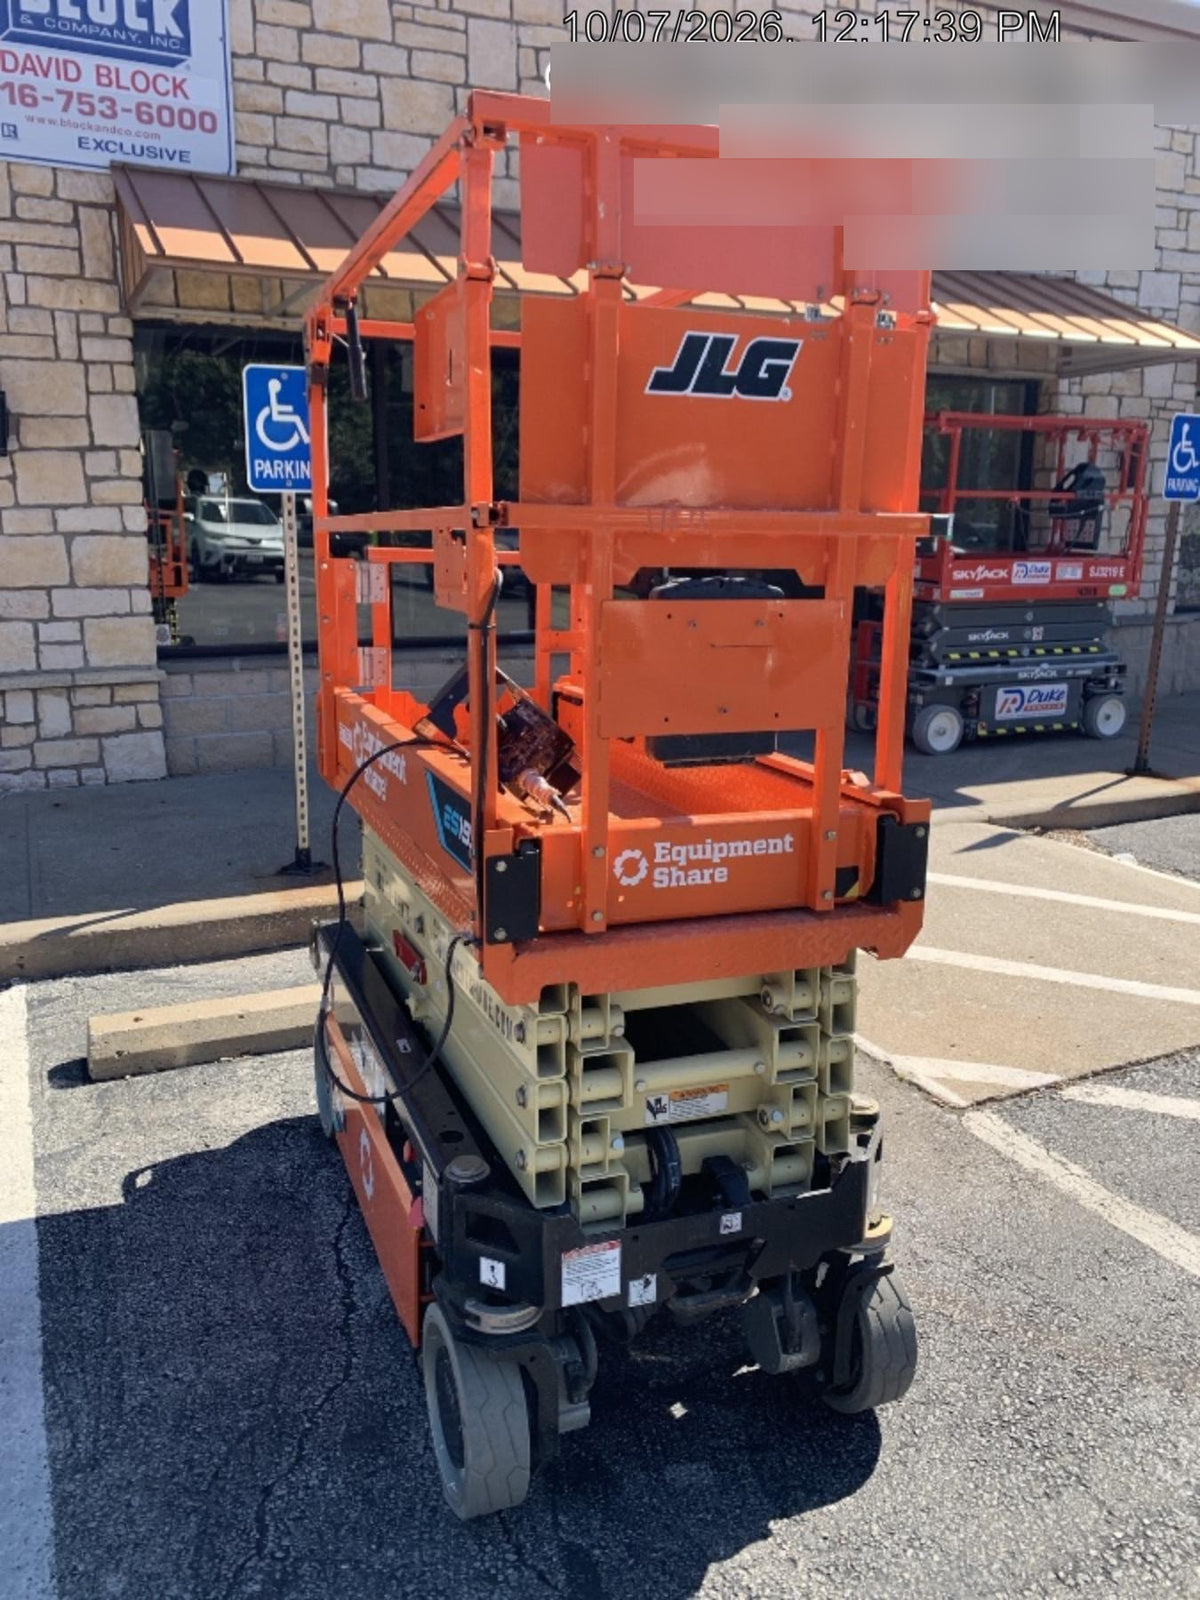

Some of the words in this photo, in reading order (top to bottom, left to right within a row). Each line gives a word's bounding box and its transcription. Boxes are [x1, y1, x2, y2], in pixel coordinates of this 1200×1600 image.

[20, 0, 184, 38] OCK
[20, 14, 34, 25] &
[0, 49, 82, 83] DAVID
[95, 63, 190, 99] BLOCK
[25, 113, 161, 141] www.blockandco.com
[77, 136, 192, 164] EXCLUSIVE
[644, 331, 803, 402] JLG
[254, 459, 311, 480] PARKIN
[952, 565, 1009, 582] SKYJACK
[654, 833, 794, 866] Equipment
[653, 867, 728, 888] Share
